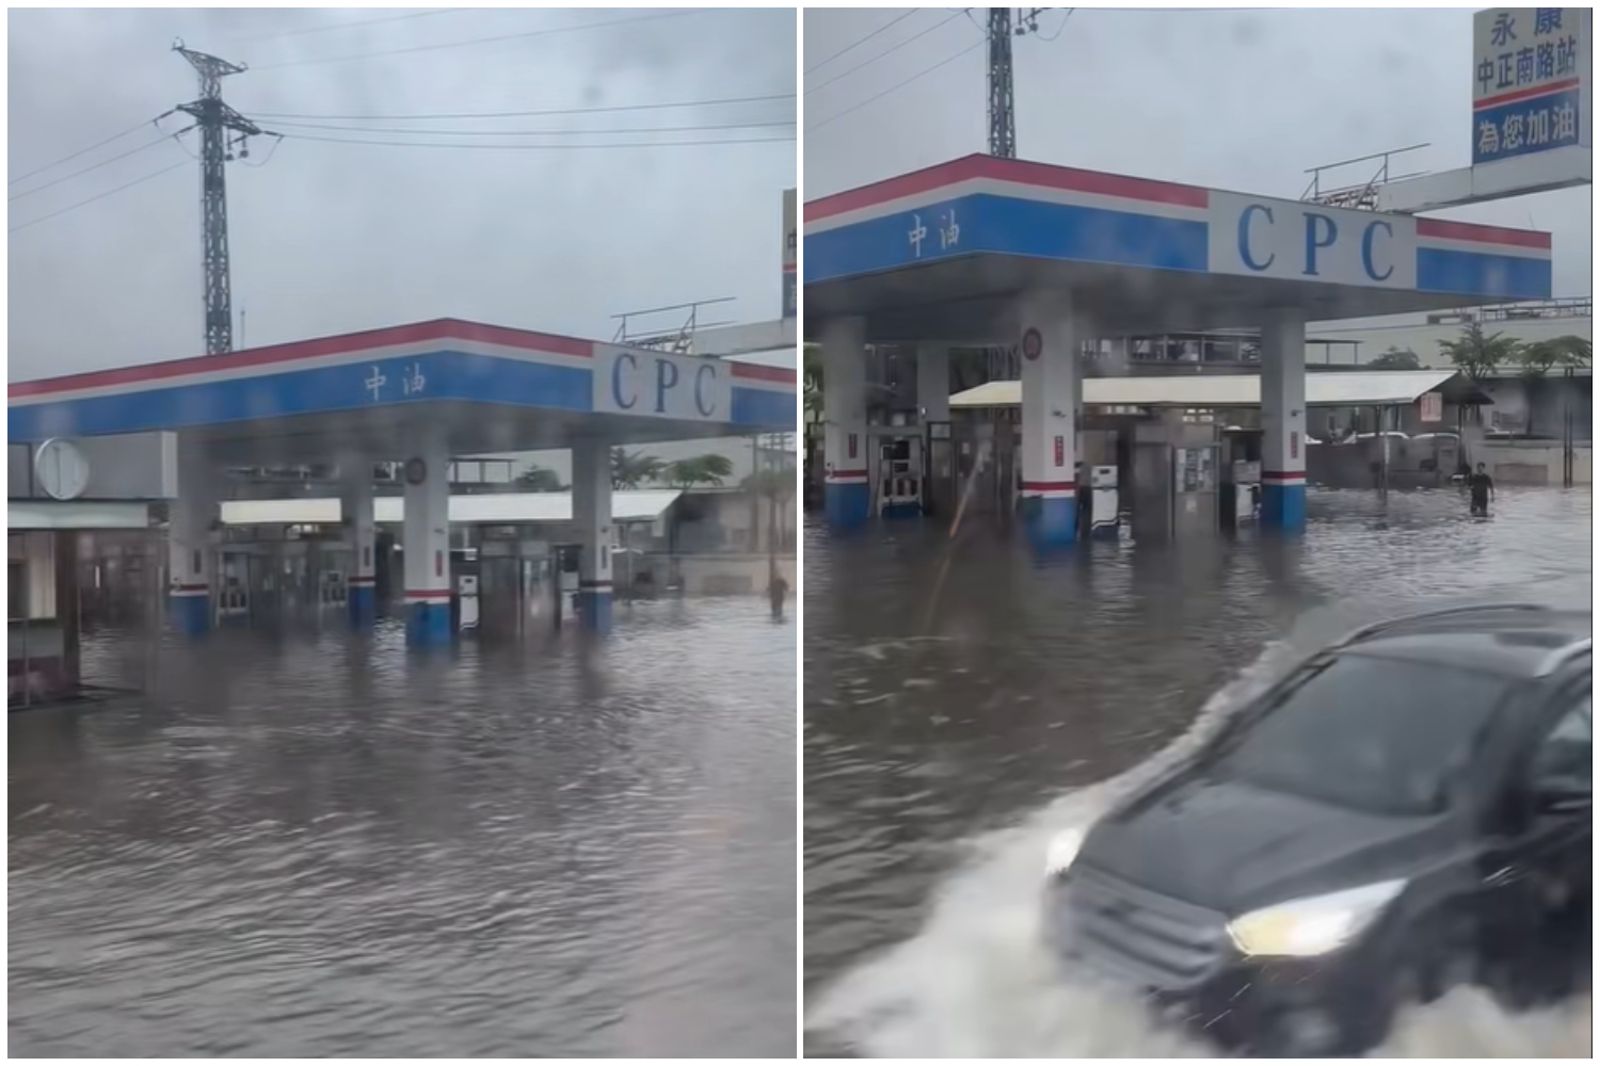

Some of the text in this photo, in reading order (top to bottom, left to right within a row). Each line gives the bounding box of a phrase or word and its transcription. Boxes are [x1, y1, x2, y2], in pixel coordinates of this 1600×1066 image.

[1478, 35, 1576, 93] 中正南路站
[1479, 104, 1576, 154] 為您加油
[908, 209, 961, 258] 中油
[1238, 204, 1394, 282] CPC
[364, 364, 425, 401] 中油
[612, 353, 716, 417] CPC
